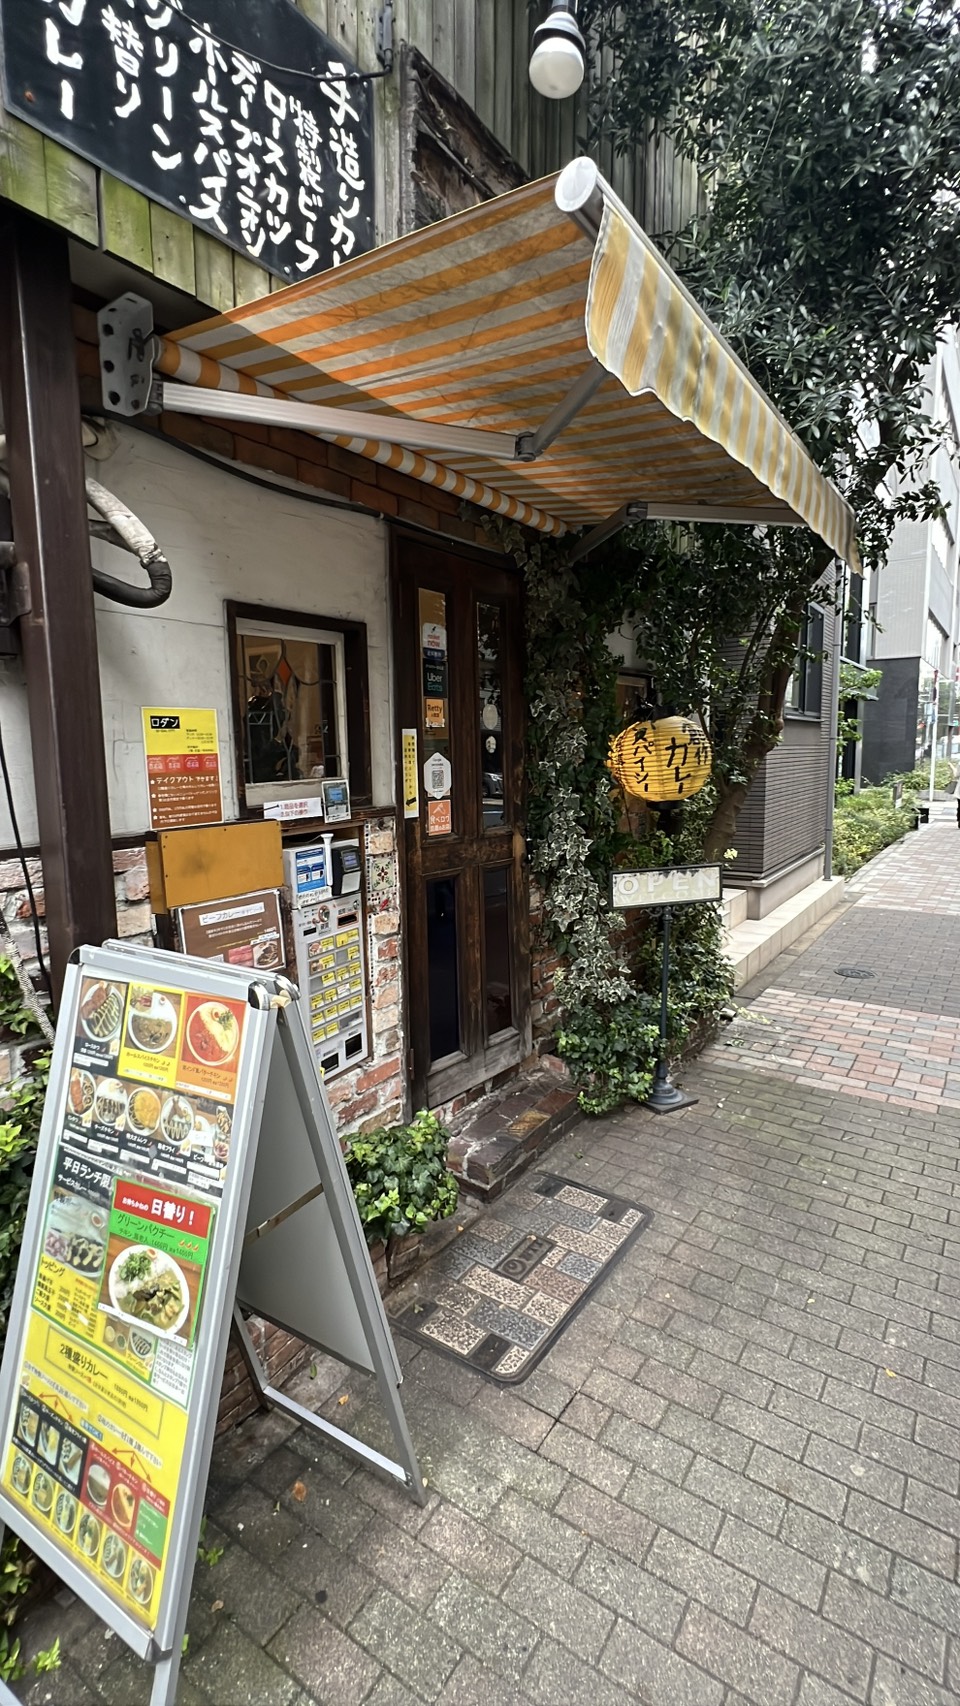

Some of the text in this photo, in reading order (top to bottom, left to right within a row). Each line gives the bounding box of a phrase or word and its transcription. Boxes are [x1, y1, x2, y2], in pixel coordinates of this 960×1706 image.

[188, 22, 232, 234] ホールスパイス
[231, 50, 266, 257] ディープオニオン
[263, 80, 292, 244] ロースカツ
[288, 95, 324, 272] 特製ビーフ
[427, 672, 443, 682] Uber
[151, 717, 179, 728] ロダン
[427, 704, 443, 714] Retty
[632, 727, 654, 793] スパイシー
[665, 736, 691, 794] カレー
[156, 775, 194, 785] テイクアウト
[618, 870, 716, 895] OPEN
[118, 1213, 175, 1239] グリーンパクチー
[41, 1256, 66, 1277] トッピング
[59, 1343, 108, 1379] 2種盛りカレー
